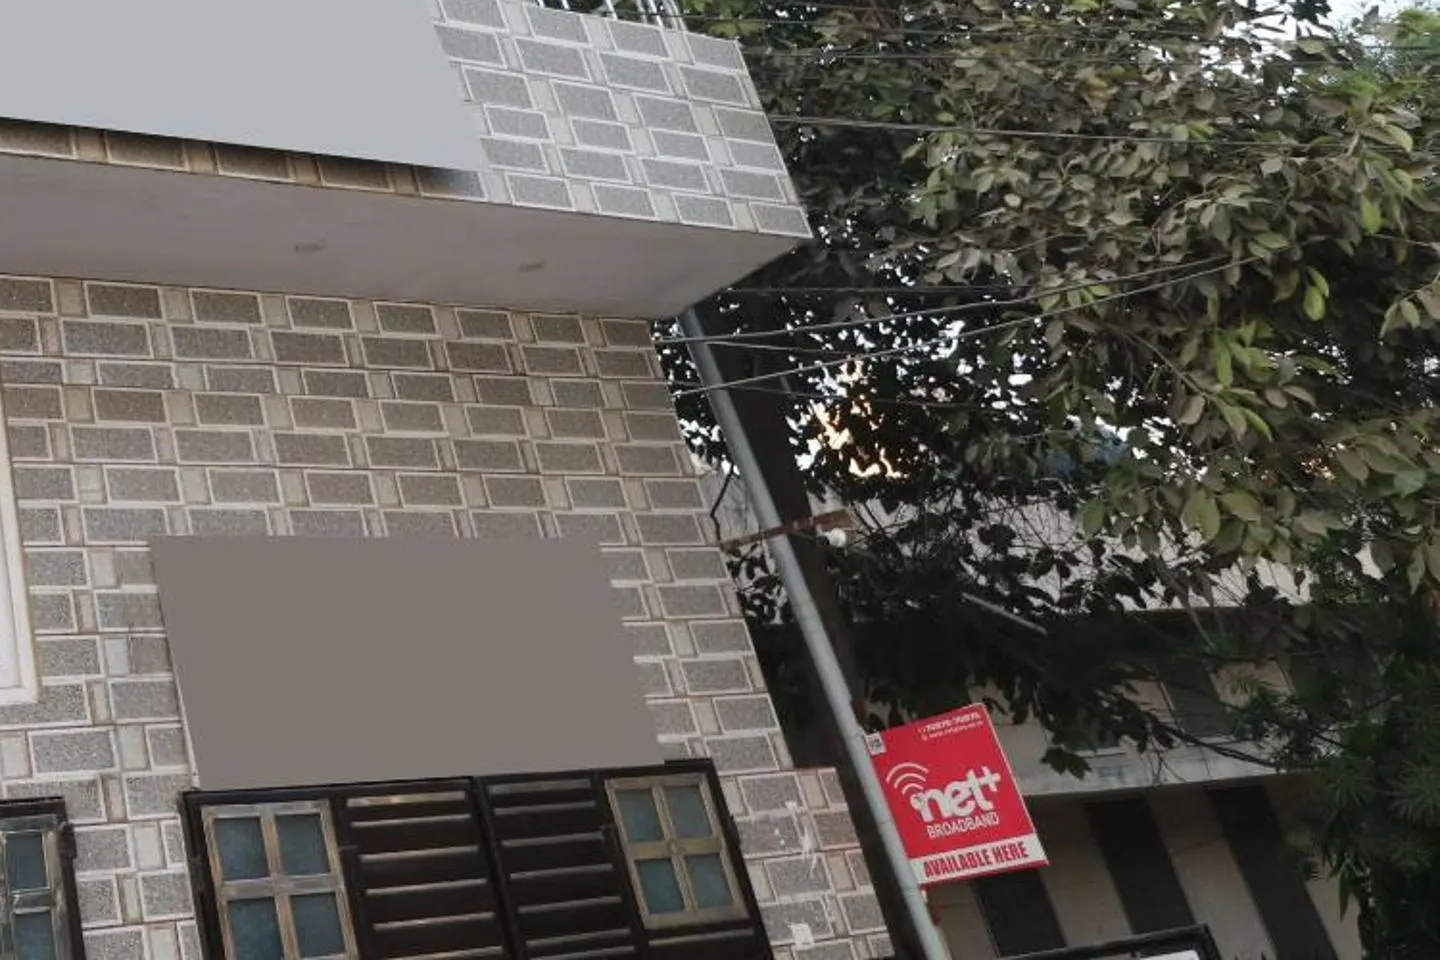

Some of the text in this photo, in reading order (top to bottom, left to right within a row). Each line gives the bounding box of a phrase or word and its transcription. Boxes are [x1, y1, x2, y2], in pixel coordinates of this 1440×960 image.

[926, 812, 1000, 839] BROADBAND
[923, 840, 1029, 877] AVAILABLE HERE
